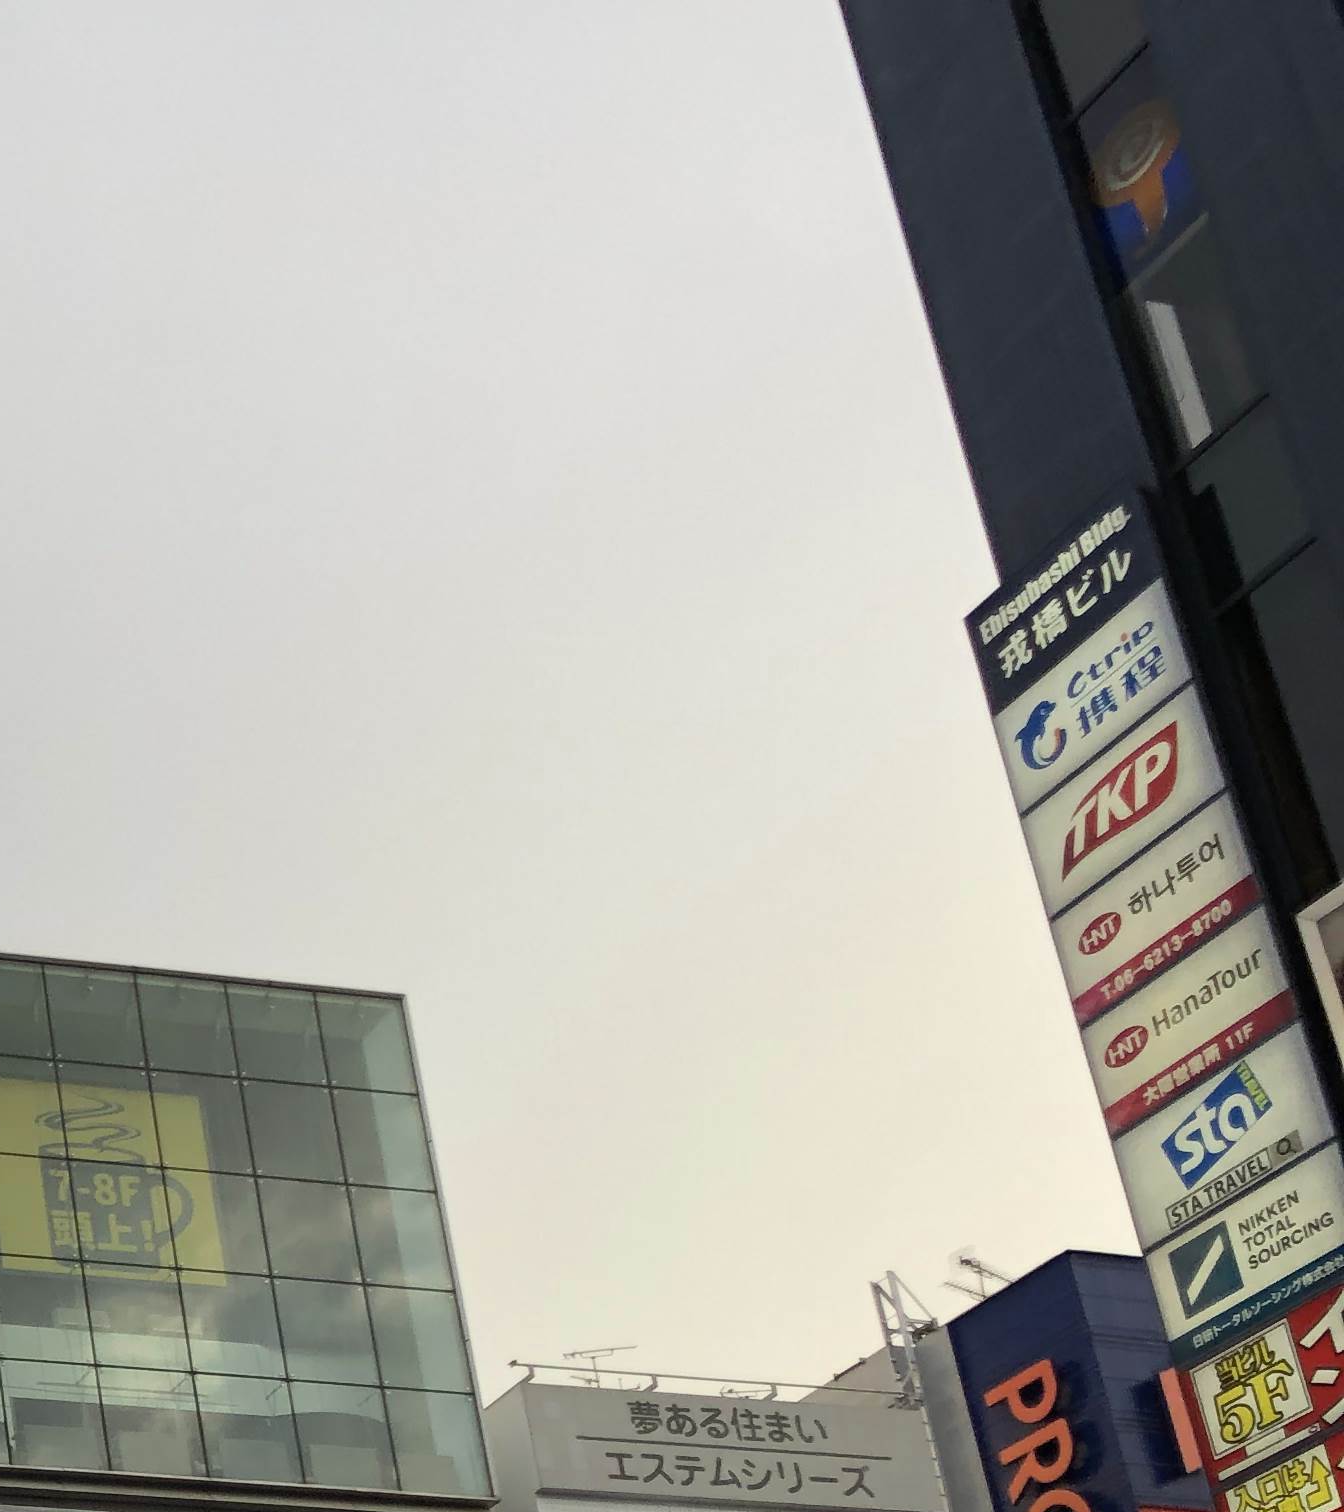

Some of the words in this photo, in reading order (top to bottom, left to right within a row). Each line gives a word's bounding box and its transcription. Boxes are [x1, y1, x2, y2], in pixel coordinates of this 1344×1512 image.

[1065, 620, 1155, 700] Ctrip
[1067, 740, 1172, 860] TKP
[1127, 832, 1226, 916] 하나투어
[1151, 948, 1263, 1037] HanaTour
[1224, 1021, 1256, 1051] 11F
[1173, 1091, 1258, 1176] sta
[49, 1168, 140, 1208] 7-8F
[1169, 1198, 1204, 1225] STA
[1202, 1152, 1269, 1205] TRAVEL
[1237, 1189, 1301, 1237] NIKKEN
[1242, 1214, 1297, 1253] TOTAL
[1247, 1211, 1335, 1271] SOURCING
[1214, 1335, 1277, 1389] 当ビル
[626, 1399, 829, 1445] 夢ある住まい
[1213, 1358, 1295, 1445] 5F
[605, 1450, 876, 1499] エステムシリーズ
